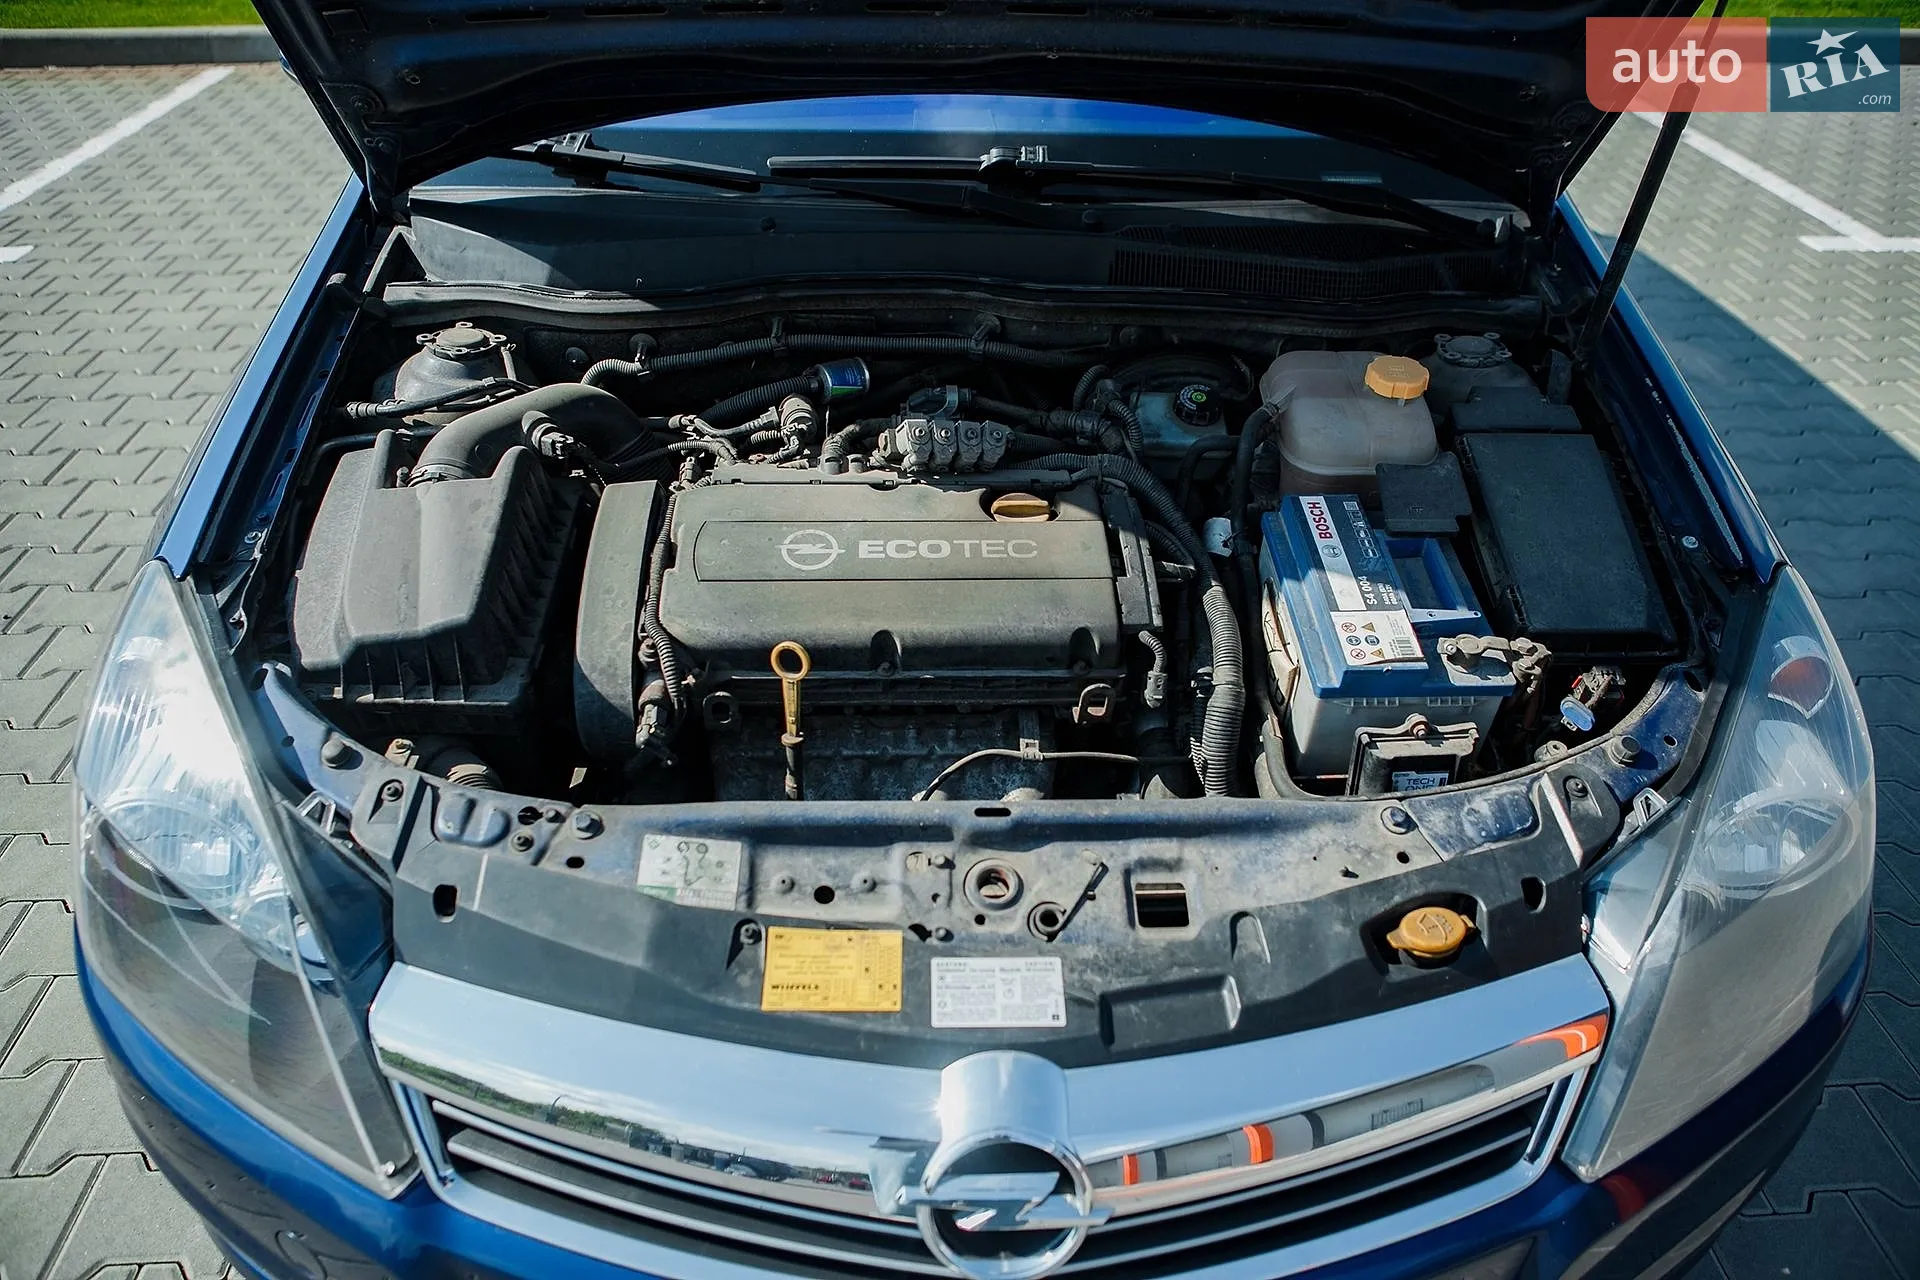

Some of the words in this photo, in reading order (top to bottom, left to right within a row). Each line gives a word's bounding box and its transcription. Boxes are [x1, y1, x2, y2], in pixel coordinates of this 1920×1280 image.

[1307, 502, 1333, 539] BOSCH
[858, 539, 1038, 559] ECOTEC
[1358, 575, 1373, 592] 004
[1364, 593, 1378, 605] S4
[1407, 777, 1435, 786] TECH
